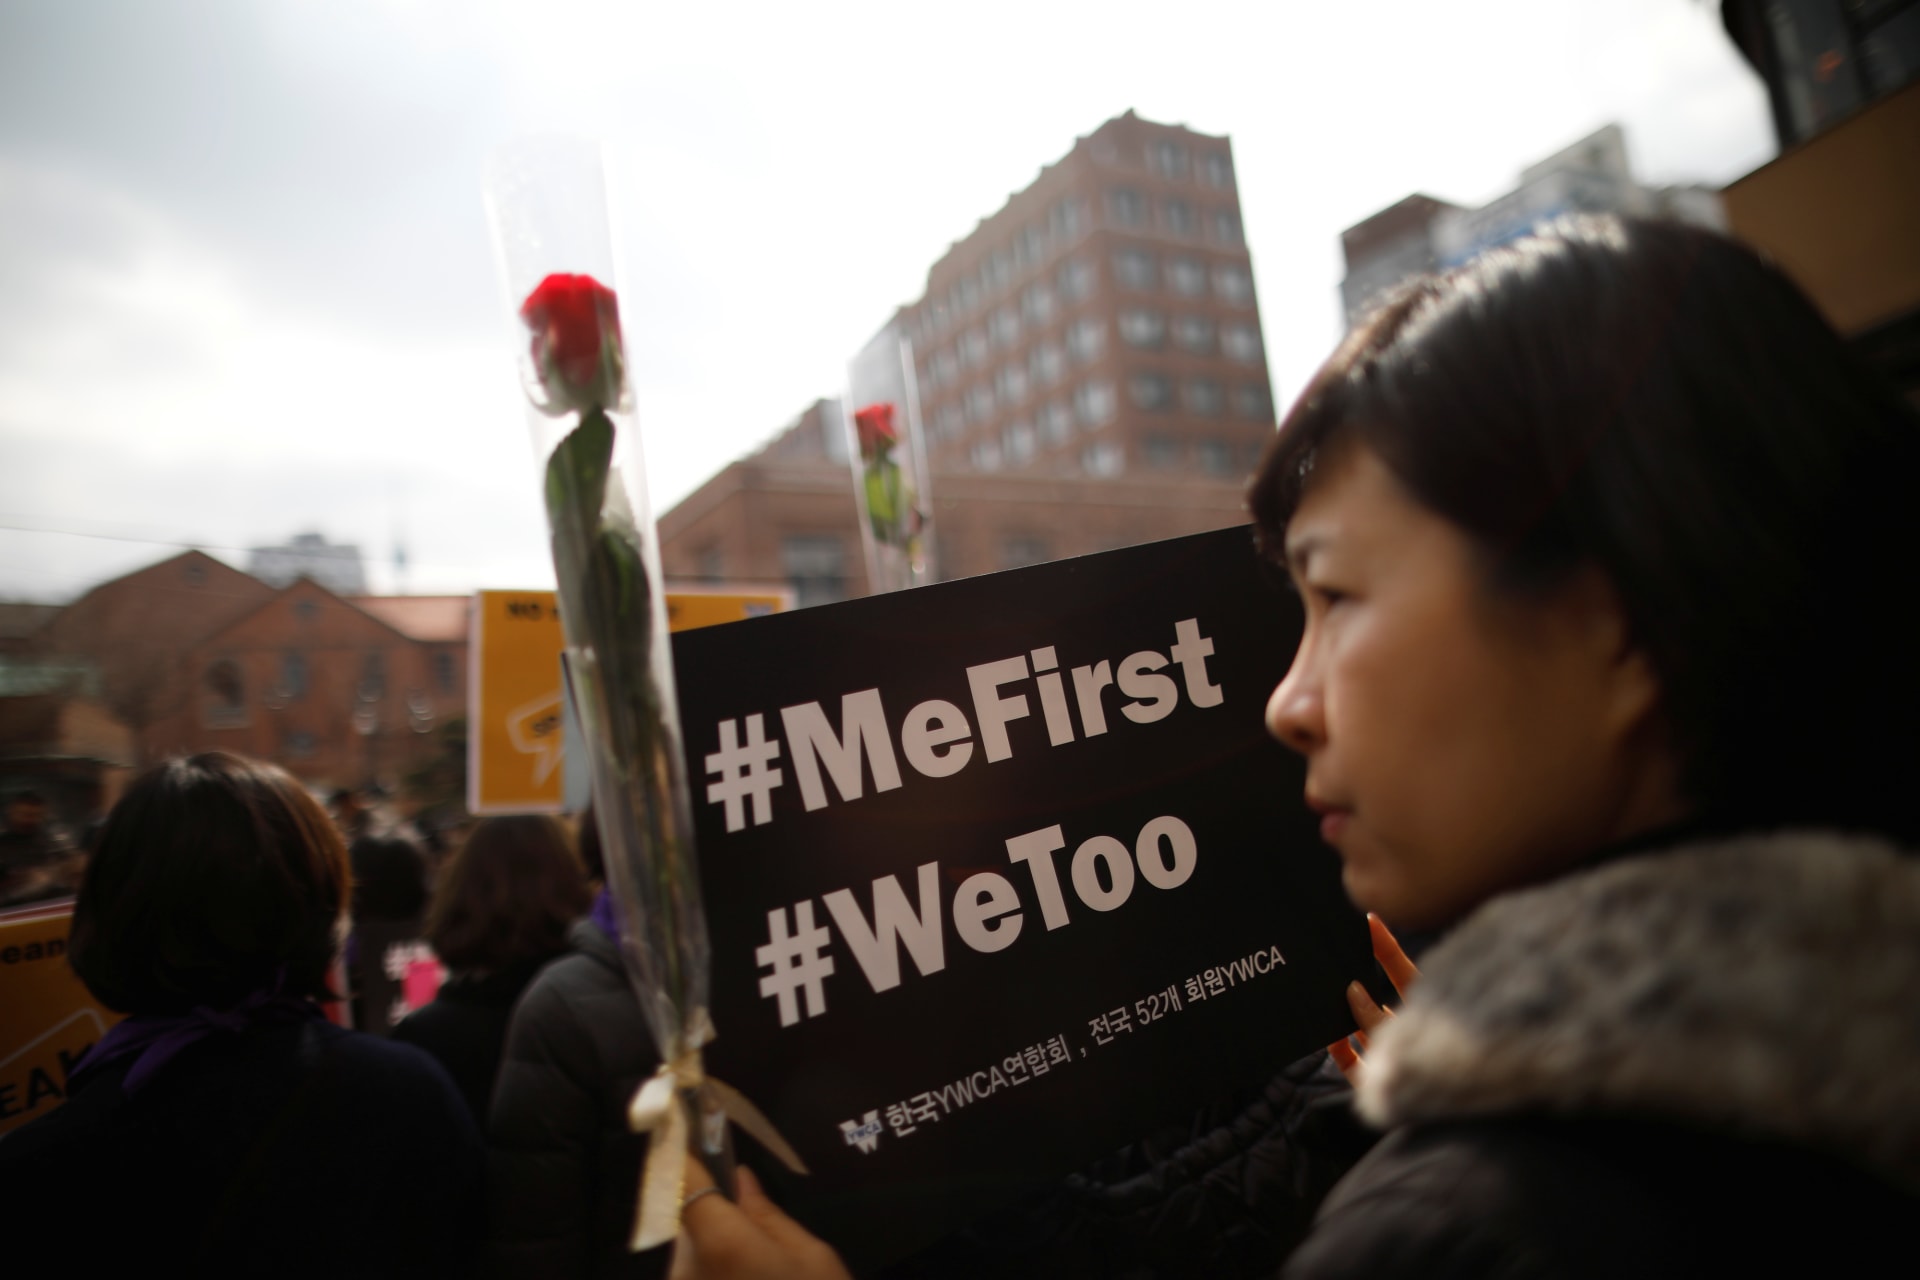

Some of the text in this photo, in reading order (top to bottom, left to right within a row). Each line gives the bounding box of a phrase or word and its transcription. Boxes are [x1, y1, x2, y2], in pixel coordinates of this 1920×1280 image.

[704, 617, 1224, 833] #MeFirst
[755, 815, 1198, 1028] #WeToo
[885, 1034, 1071, 1138] 한국YWCA연합회
[1087, 1006, 1133, 1046] 전국
[1135, 984, 1183, 1026] 52개
[1184, 945, 1287, 1003] 회원YWCA
